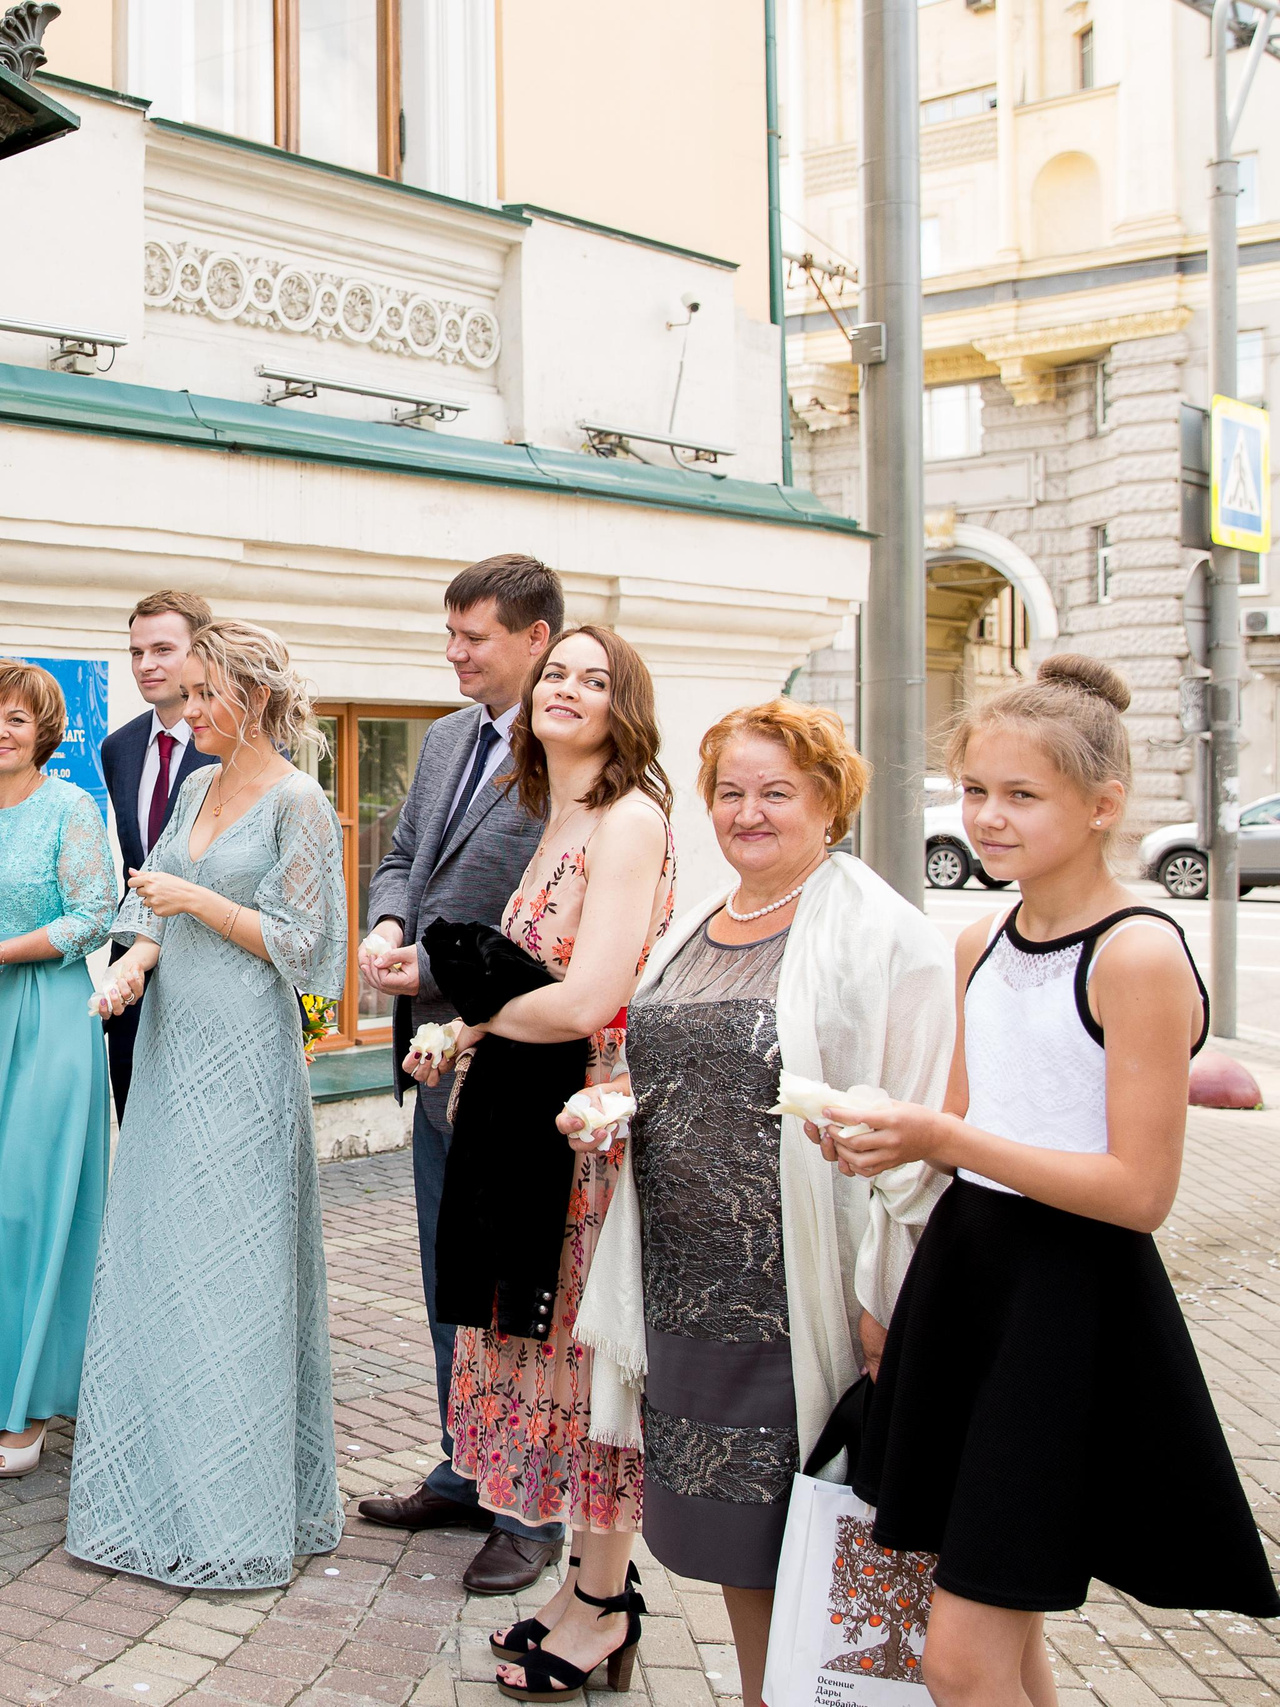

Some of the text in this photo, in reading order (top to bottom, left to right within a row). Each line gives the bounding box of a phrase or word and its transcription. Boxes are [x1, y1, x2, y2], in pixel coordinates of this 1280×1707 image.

[49, 768, 70, 778] 18.00
[817, 1675, 855, 1690] Осенние
[815, 1685, 842, 1698] Дары
